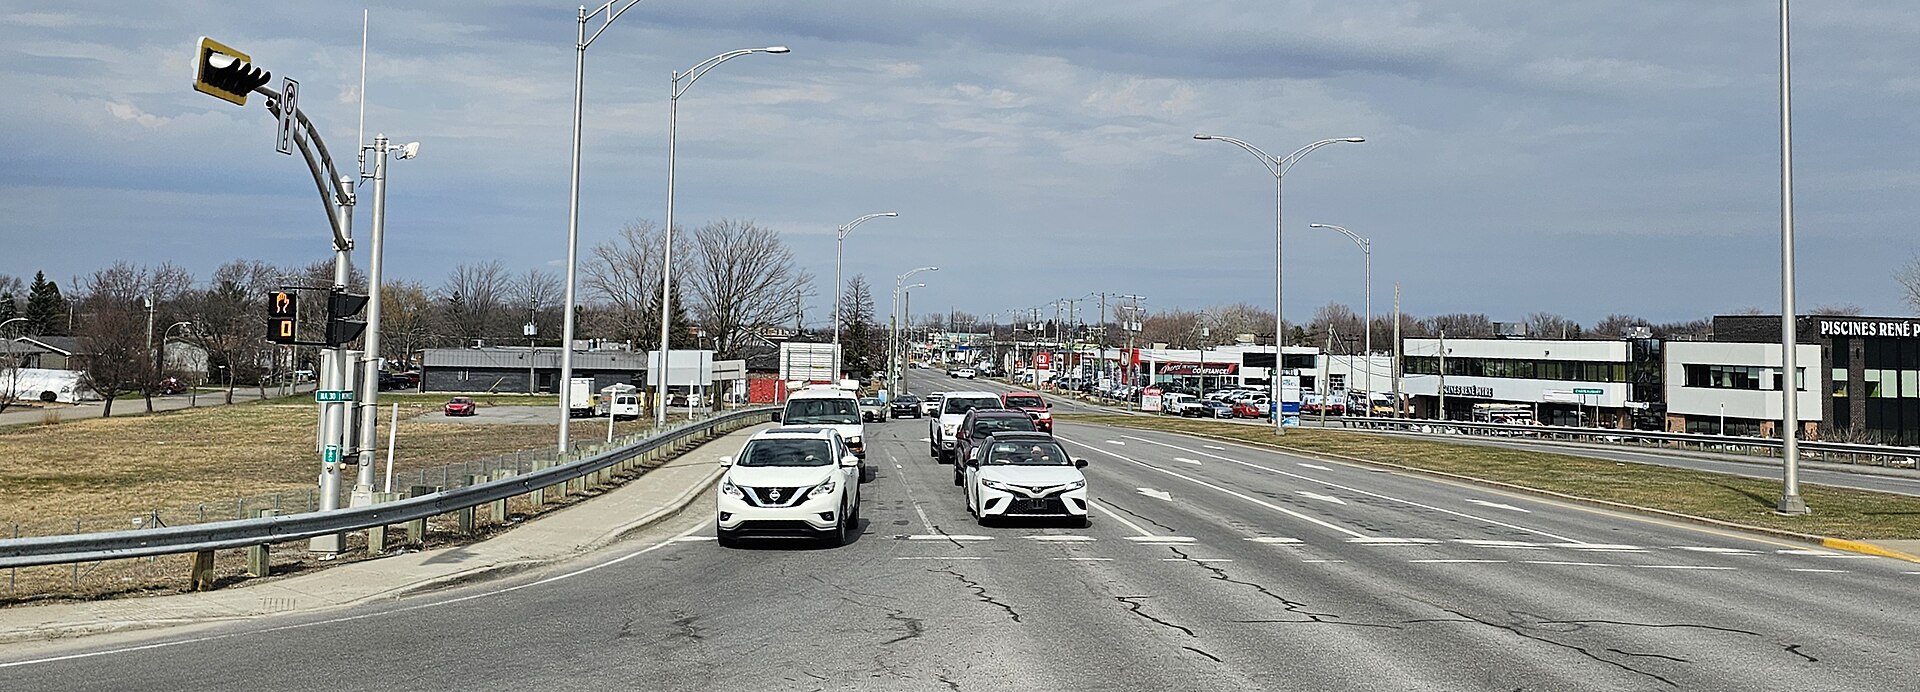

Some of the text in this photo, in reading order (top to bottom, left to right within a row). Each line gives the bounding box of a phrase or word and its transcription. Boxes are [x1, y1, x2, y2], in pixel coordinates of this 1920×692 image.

[281, 320, 292, 337] 0
[1820, 320, 1877, 336] PISCINES
[1878, 320, 1911, 337] RENÉ
